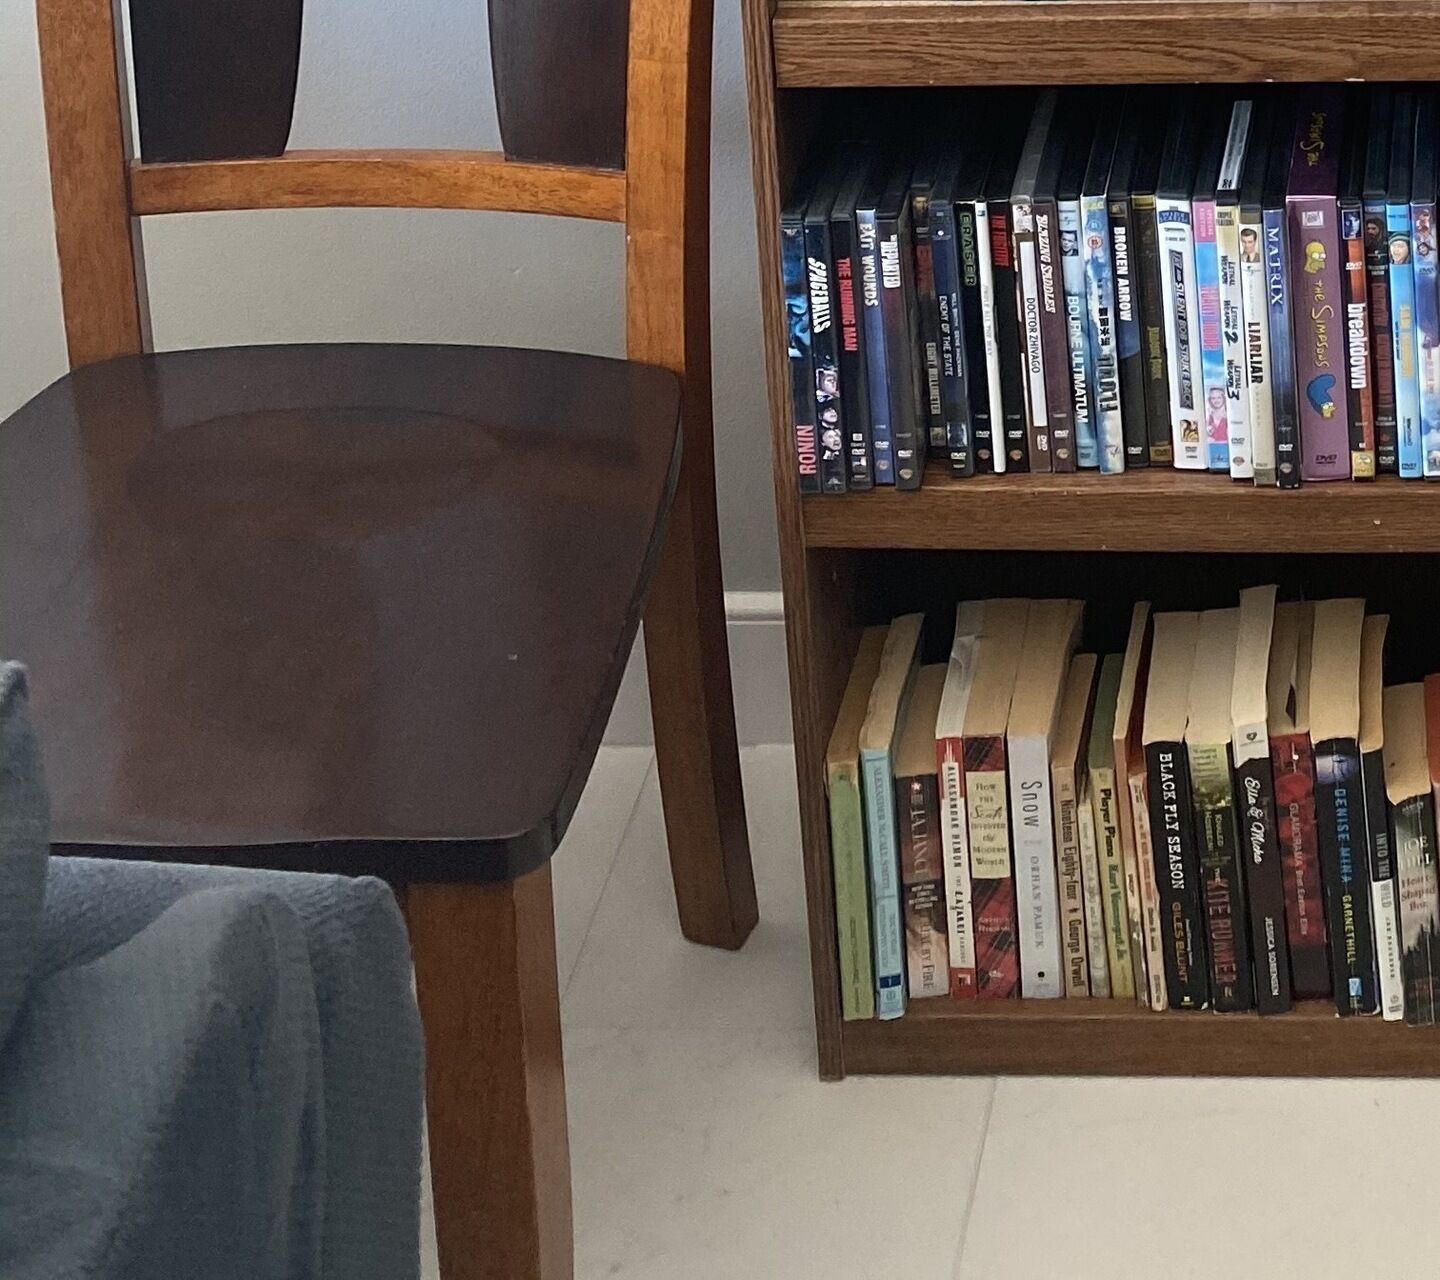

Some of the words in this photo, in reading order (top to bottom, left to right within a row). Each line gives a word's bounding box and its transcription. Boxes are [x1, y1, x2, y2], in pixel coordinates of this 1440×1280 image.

[1113, 227, 1129, 275] BROKEN
[1267, 227, 1283, 304] MATRIX
[808, 258, 831, 333] SPACEBALLS
[1026, 298, 1038, 333] DOCTOR
[1117, 278, 1132, 321] ARROW
[1028, 335, 1041, 373] ZHIVAGO
[1347, 303, 1368, 389] breakdown
[795, 425, 817, 474] RONIN
[1159, 753, 1177, 800] BLACK
[1019, 781, 1043, 827] Snow
[1061, 800, 1078, 843] Nineteen
[1099, 788, 1113, 824] Player
[1103, 827, 1117, 858] Piano
[1165, 836, 1185, 889] SEASON
[1062, 846, 1080, 900] Eighty-four
[1068, 920, 1083, 954] George
[1070, 957, 1086, 987] Orwell
